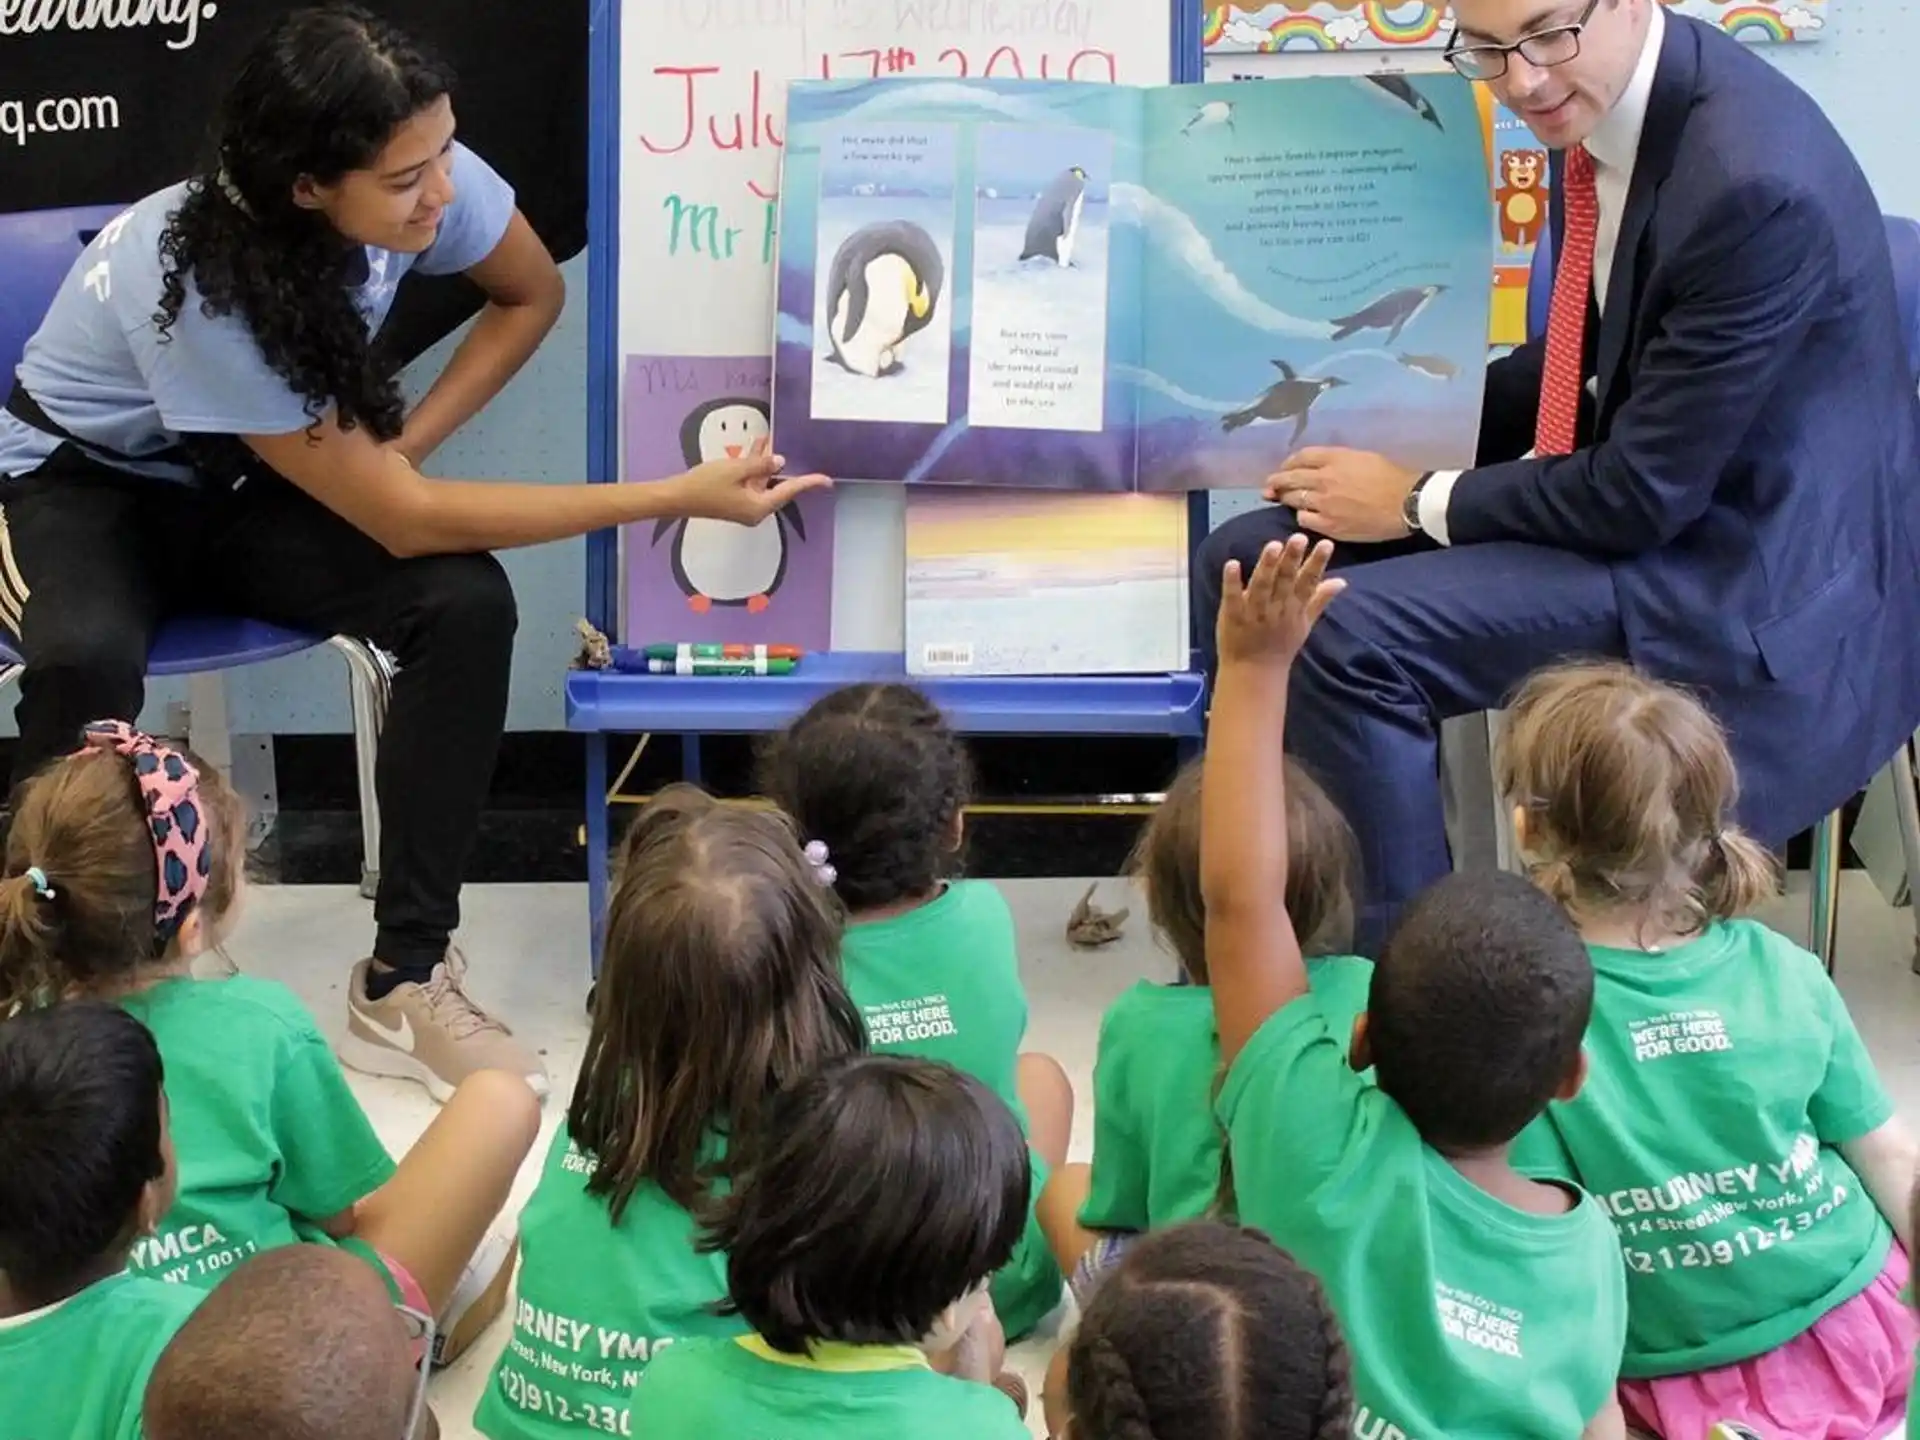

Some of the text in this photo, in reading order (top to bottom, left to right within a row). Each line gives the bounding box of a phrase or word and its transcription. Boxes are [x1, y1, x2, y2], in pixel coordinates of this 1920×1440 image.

[912, 1004, 951, 1023] HERE
[869, 1019, 958, 1045] FOR GOOD.
[1635, 1038, 1673, 1063] FOR
[130, 1222, 227, 1270] YMCA
[161, 1263, 191, 1285] NY
[571, 1362, 619, 1390] York,
[622, 1369, 644, 1388] N
